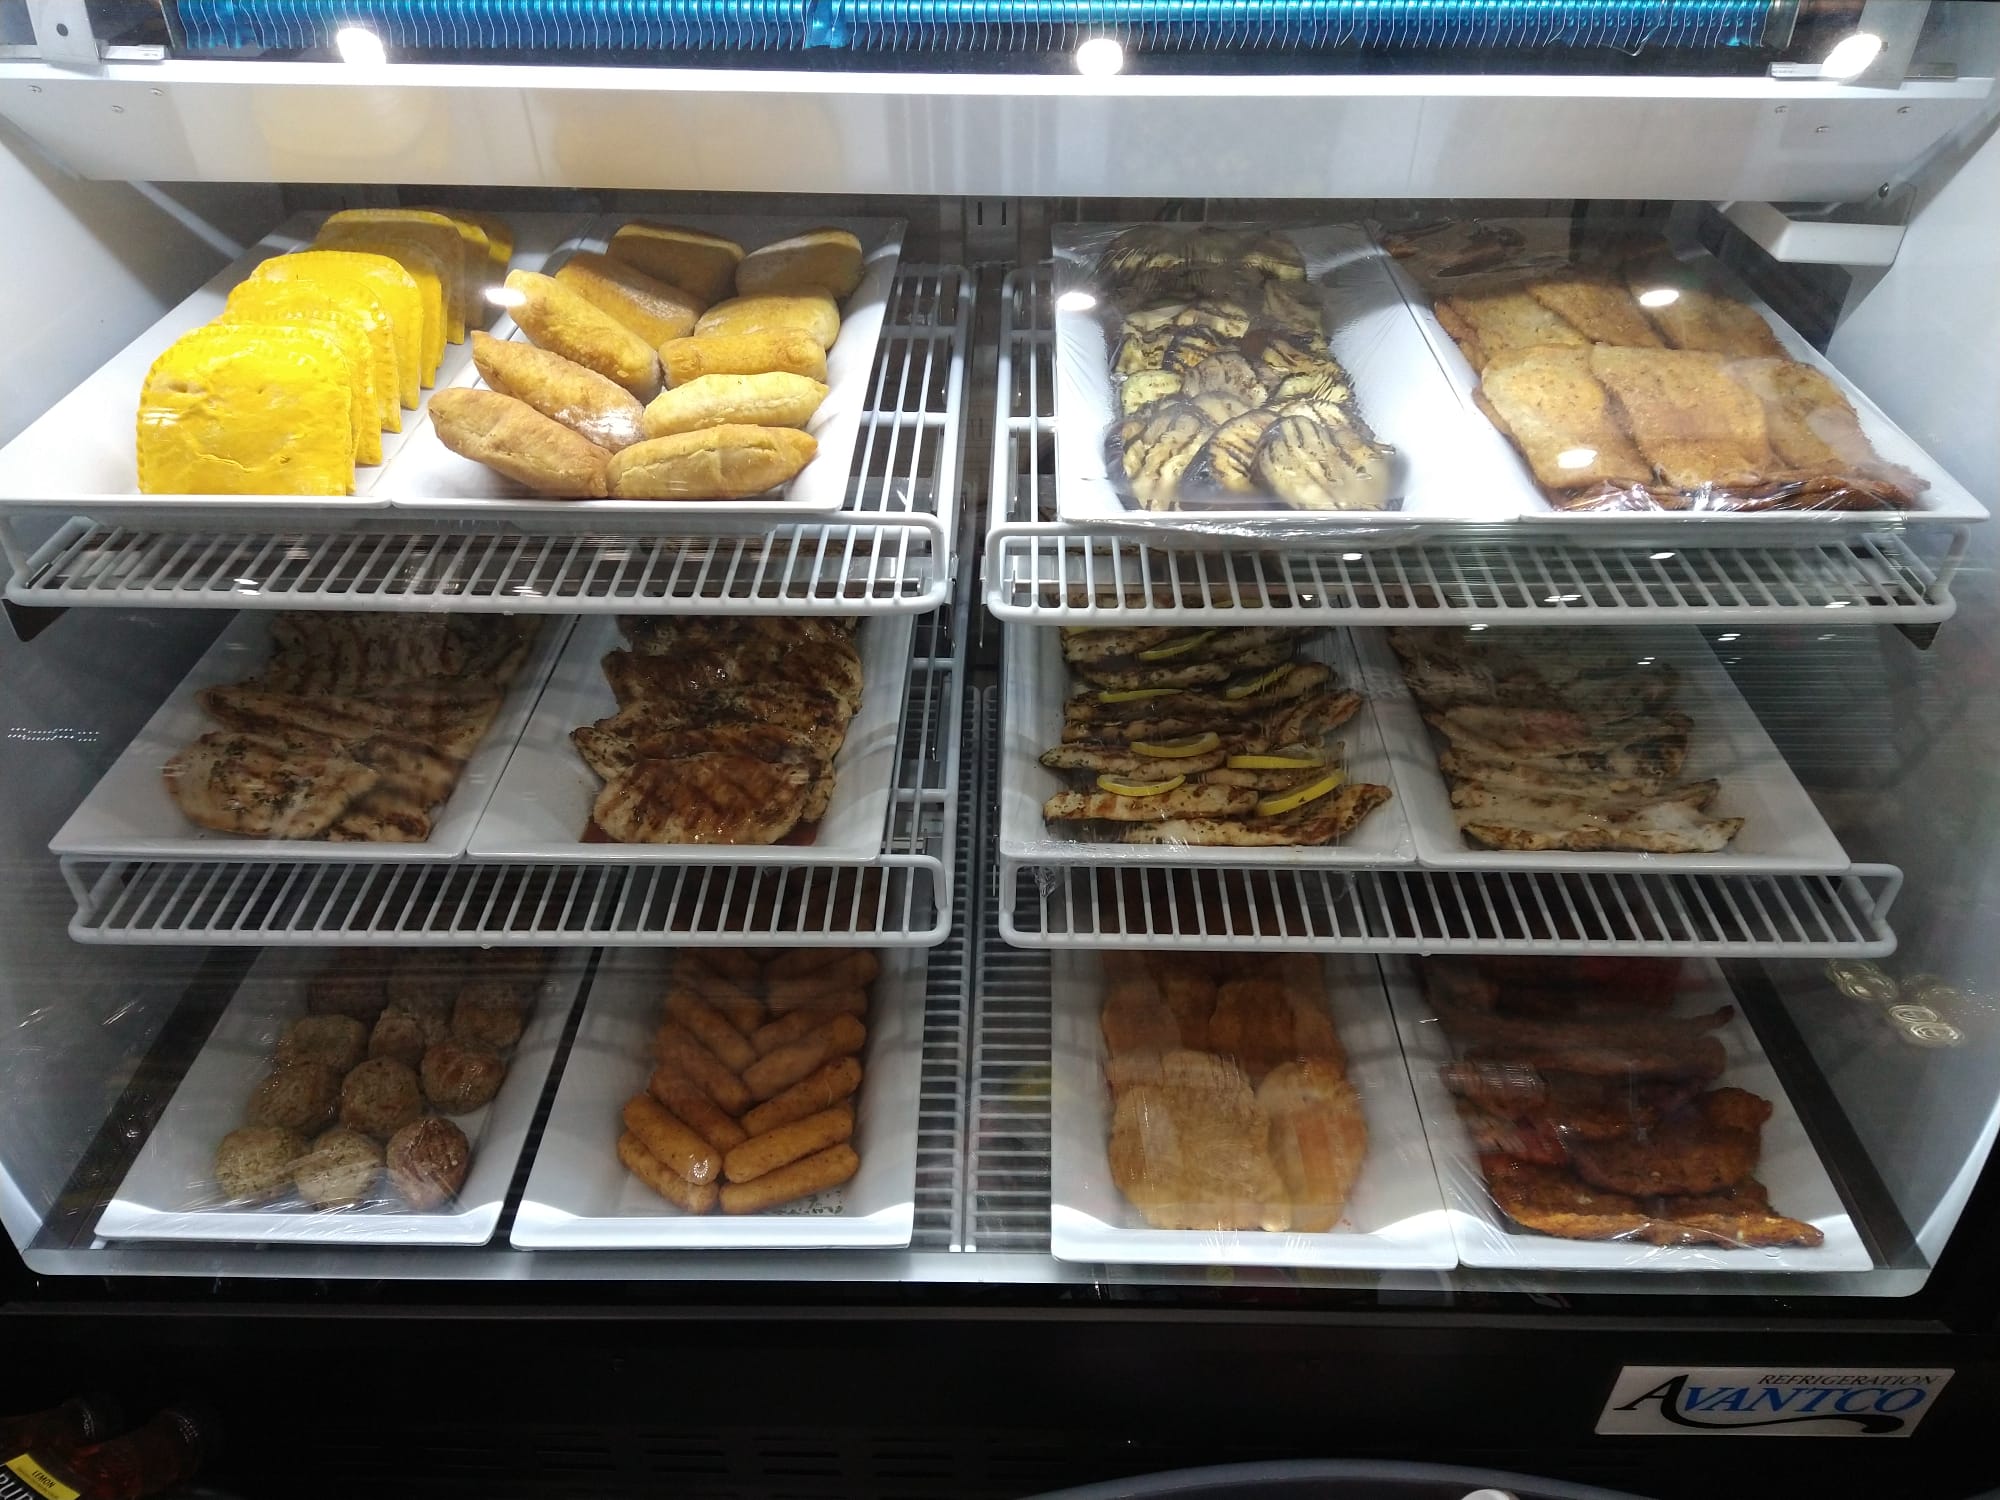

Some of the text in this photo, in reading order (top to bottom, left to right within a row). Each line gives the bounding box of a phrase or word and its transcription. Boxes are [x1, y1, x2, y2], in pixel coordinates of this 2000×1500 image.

[1757, 1374, 1938, 1386] REFRIGERATION
[1613, 1374, 1926, 1432] AVANTCO
[32, 1470, 57, 1488] LEMON
